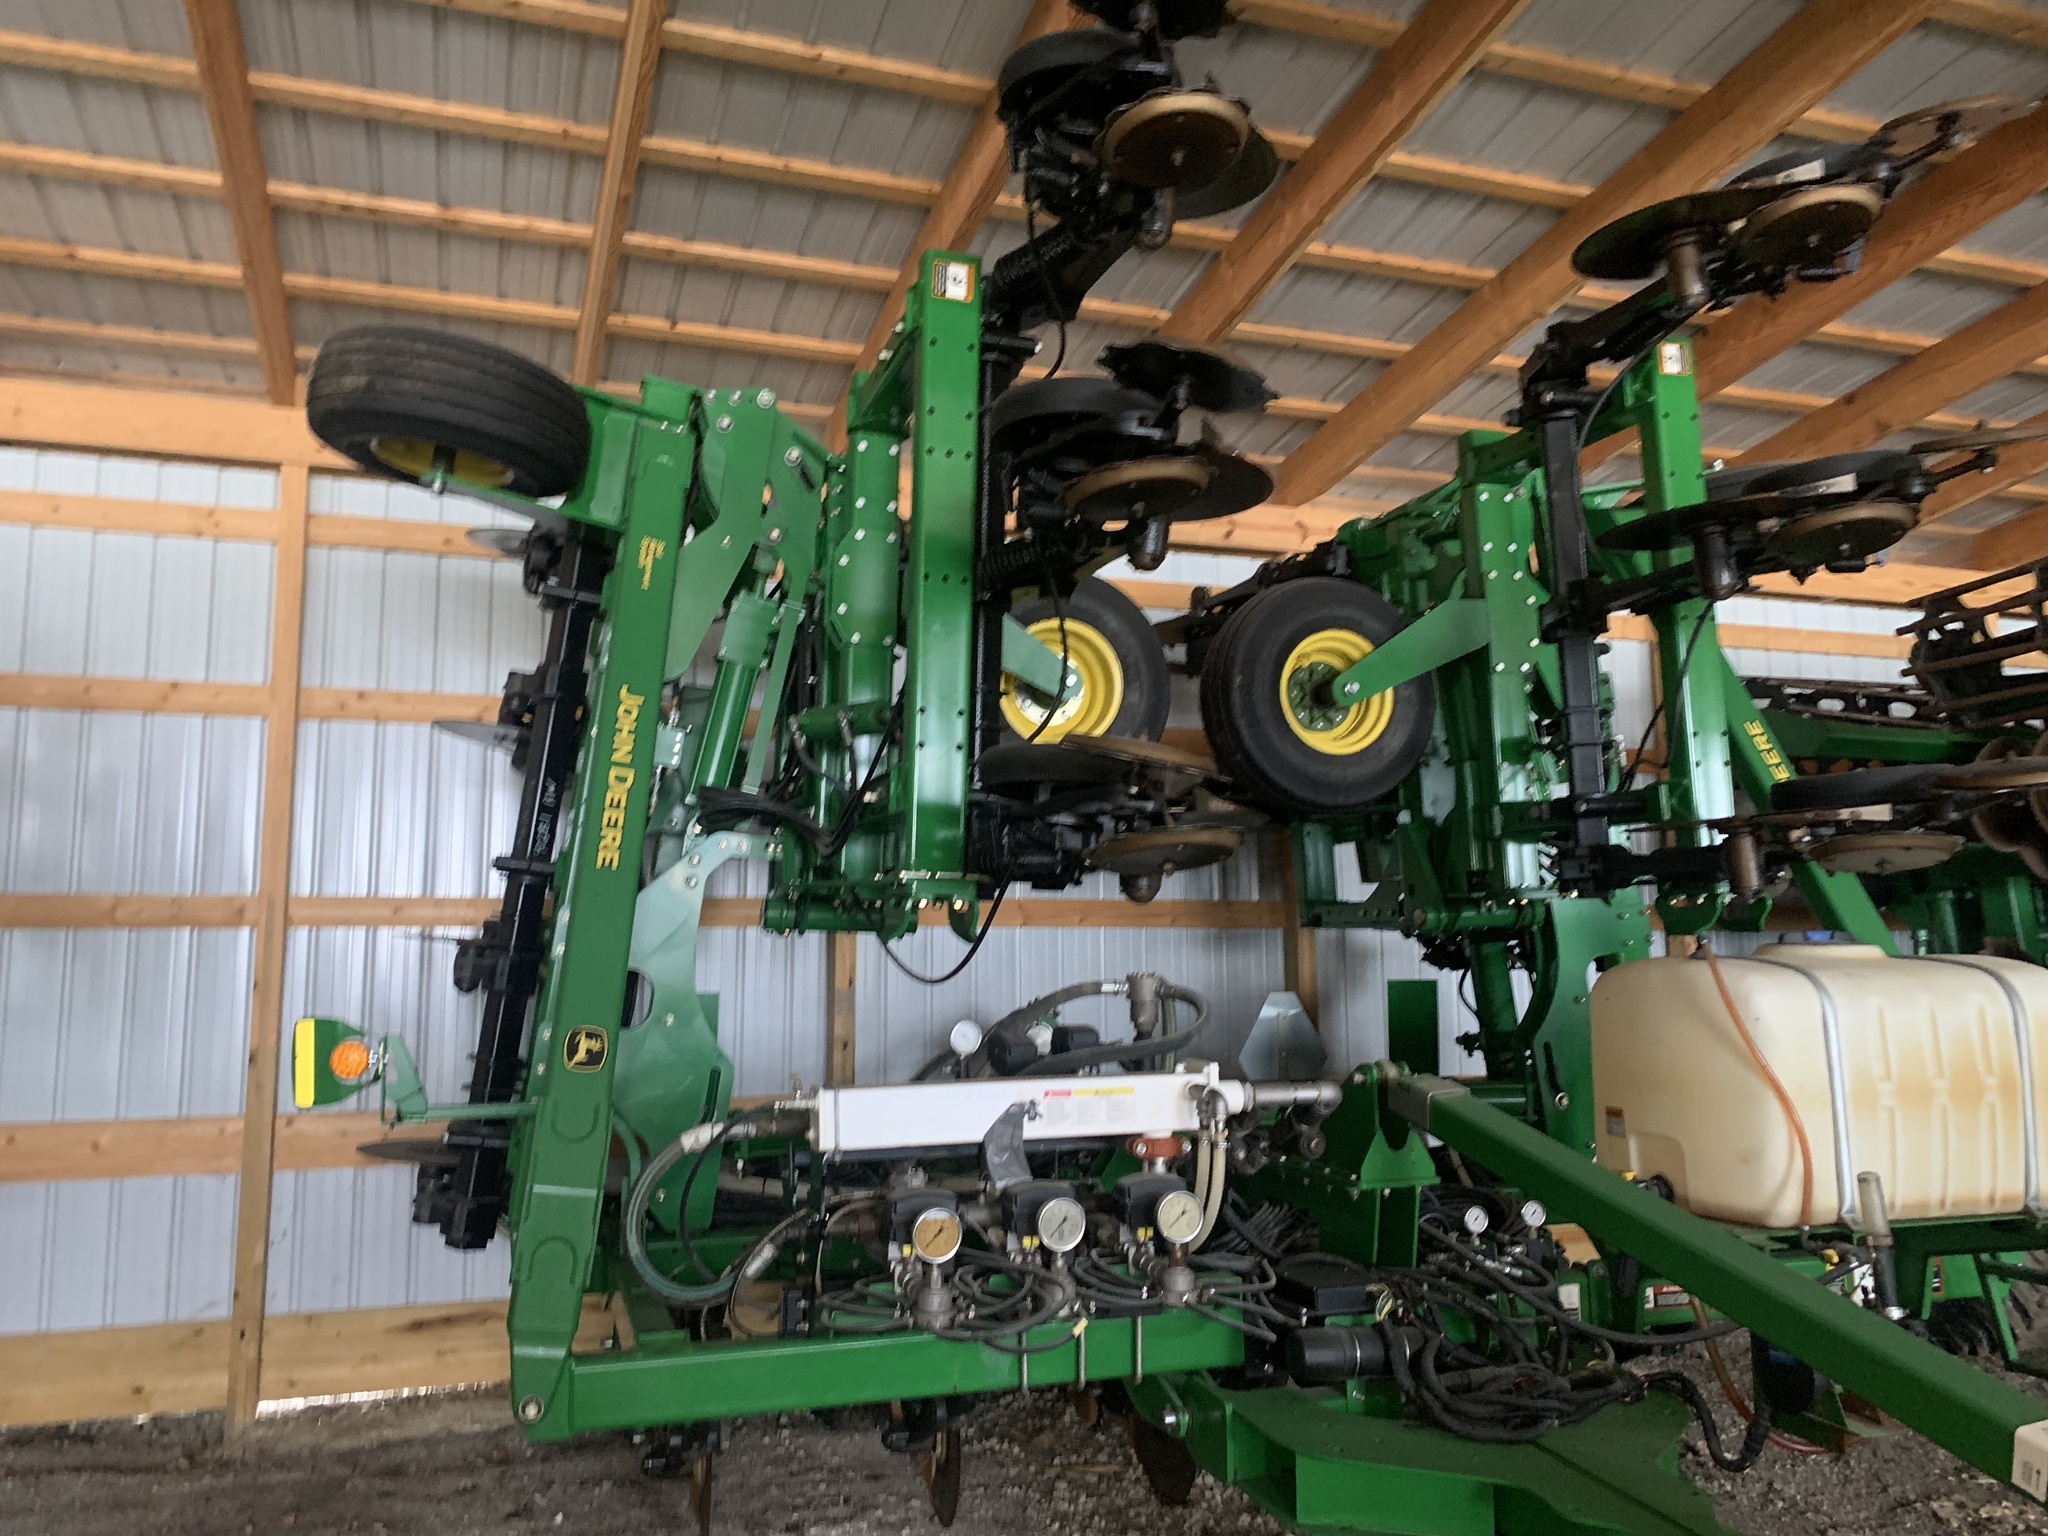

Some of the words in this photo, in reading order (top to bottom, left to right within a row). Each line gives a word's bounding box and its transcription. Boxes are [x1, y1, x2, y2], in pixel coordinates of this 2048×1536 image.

[611, 684, 645, 763] JOHN
[1743, 720, 1790, 783] EERE
[596, 766, 636, 871] DEERE
